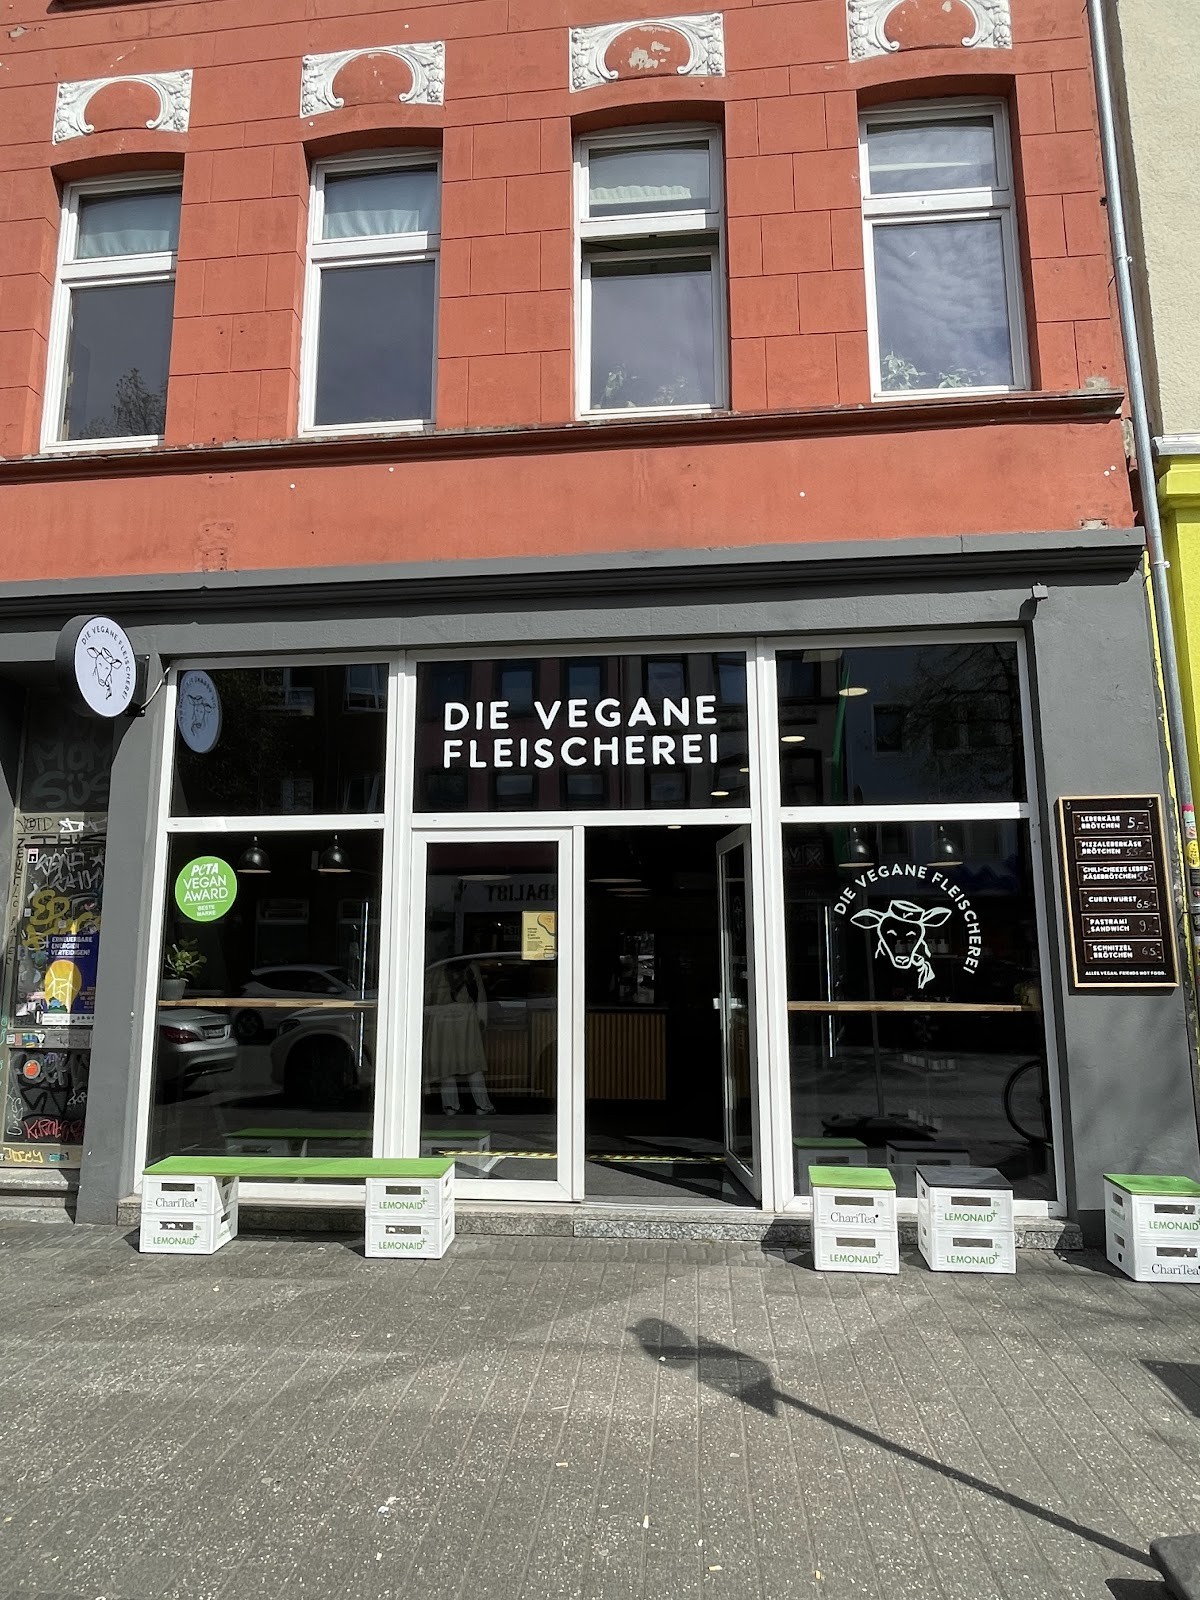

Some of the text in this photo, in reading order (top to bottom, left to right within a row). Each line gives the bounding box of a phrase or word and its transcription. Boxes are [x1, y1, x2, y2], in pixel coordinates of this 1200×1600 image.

[81, 625, 131, 700] DIE VEGANE FLEISCHEREI
[444, 695, 718, 731] DIE VEGANE
[443, 733, 718, 769] FLEISCHEREI
[183, 875, 227, 889] VEGAN
[183, 887, 228, 902] AWARD
[833, 863, 981, 974] DIE VEGANE FLEISCHEREI
[1093, 951, 1133, 959] BRÖTCHEN
[155, 1197, 199, 1208] ChariTea
[830, 1212, 877, 1224] ChariTea
[1151, 1264, 1200, 1275] ChariTea
